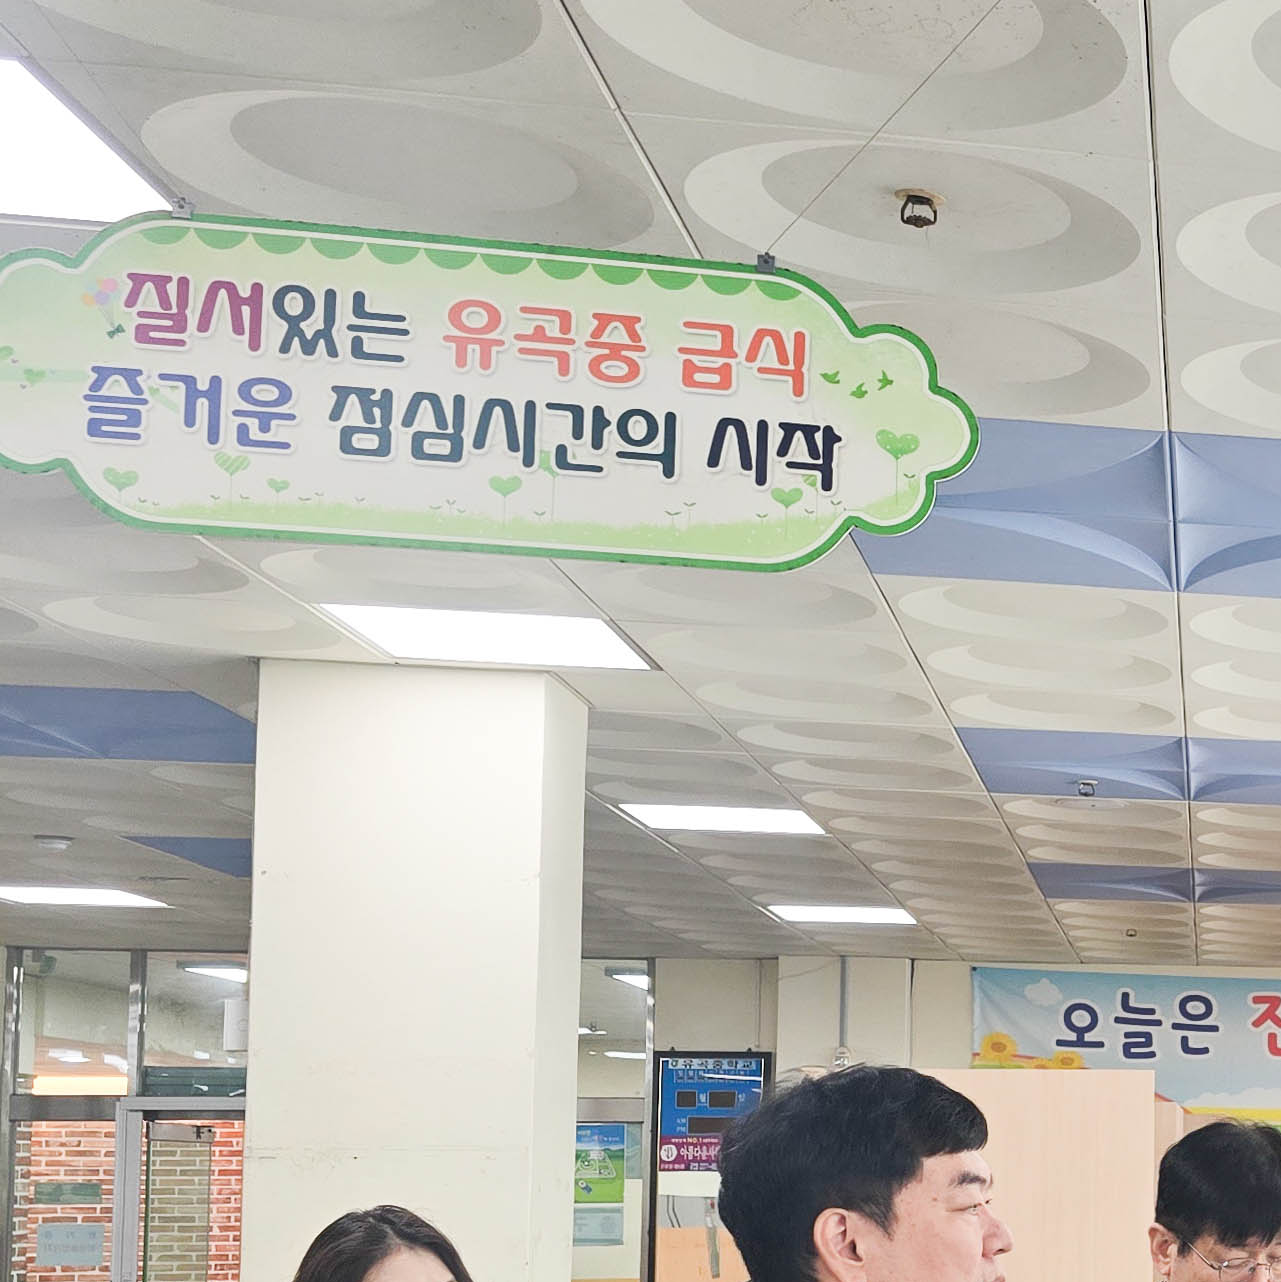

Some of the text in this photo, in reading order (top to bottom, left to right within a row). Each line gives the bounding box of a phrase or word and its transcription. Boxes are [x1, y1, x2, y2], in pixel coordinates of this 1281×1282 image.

[124, 272, 807, 398] 질서있는 유곡중 급식
[83, 365, 843, 492] 즐거운 점심시간의 시작
[1056, 991, 1220, 1060] 오늘은
